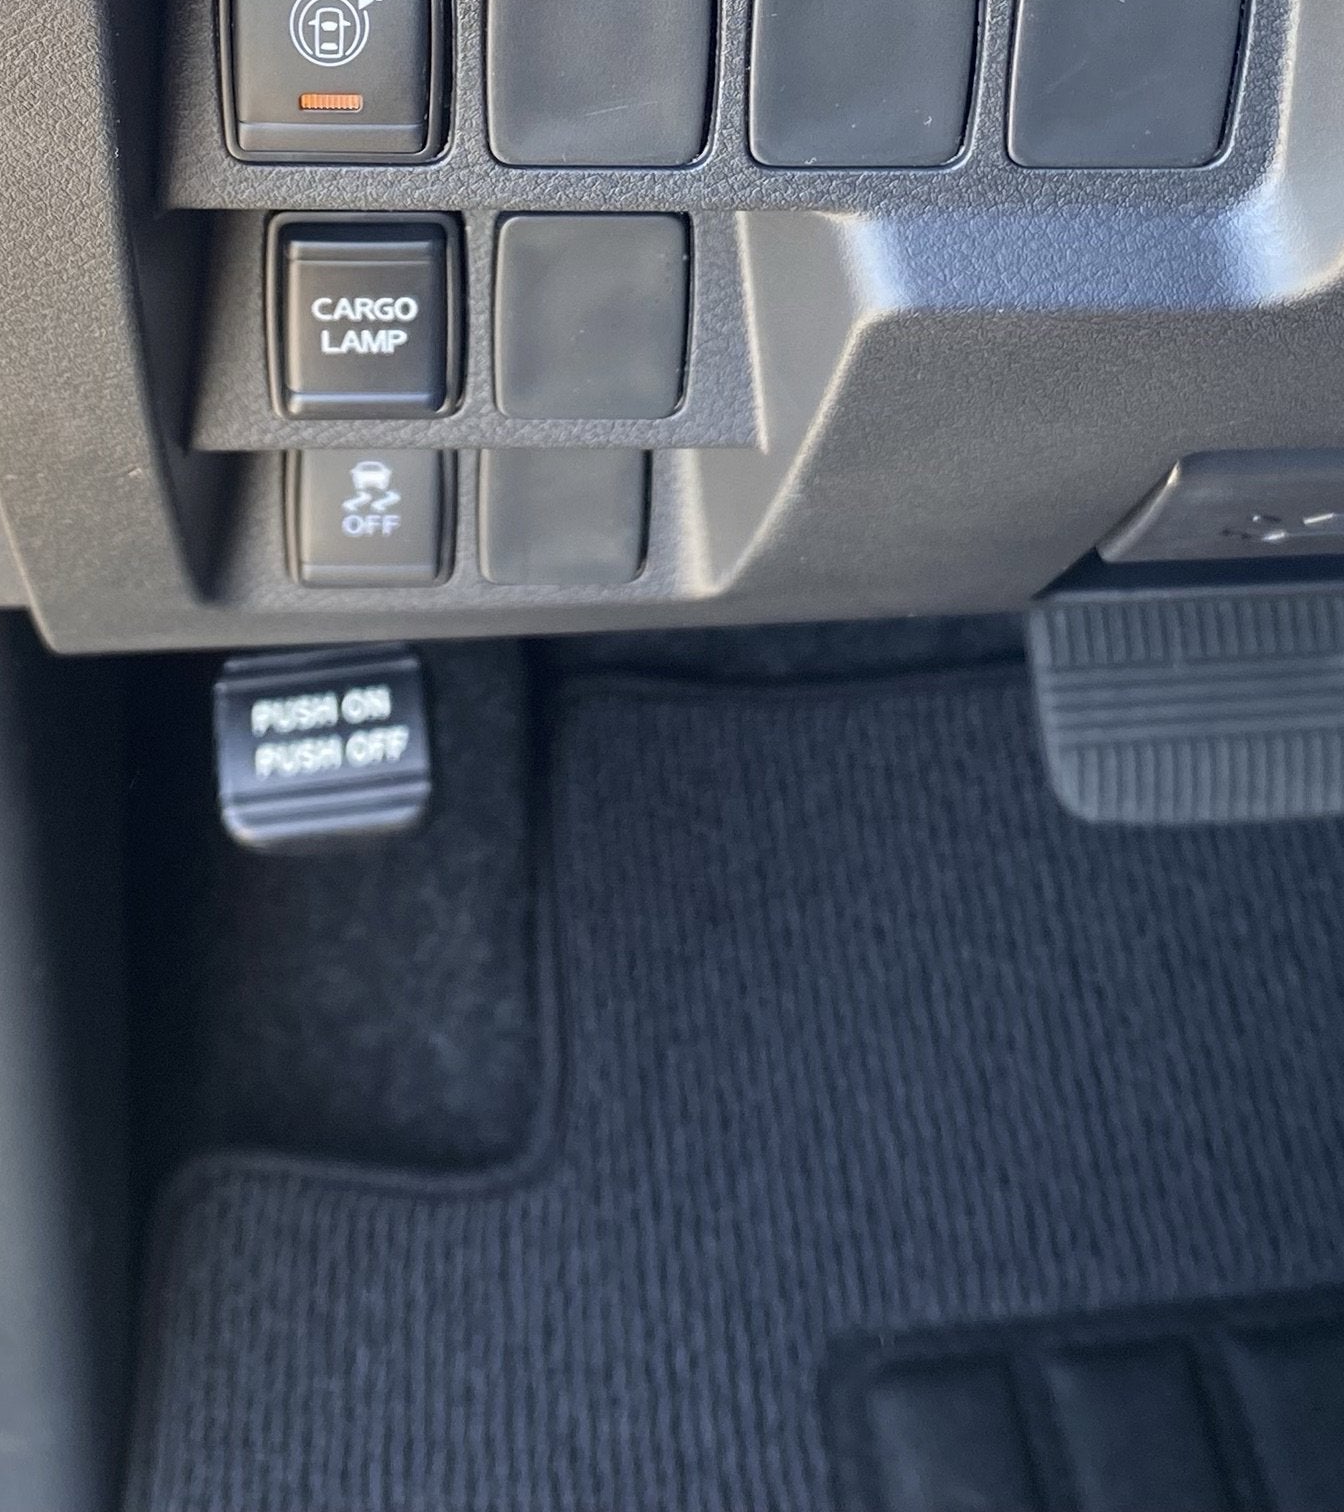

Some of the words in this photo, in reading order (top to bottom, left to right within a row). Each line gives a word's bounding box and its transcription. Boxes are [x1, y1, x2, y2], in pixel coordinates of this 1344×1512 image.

[311, 296, 419, 322] CARGO
[320, 329, 409, 355] LAMP
[341, 514, 402, 536] OFF
[251, 691, 339, 738] PUSH
[341, 683, 392, 725] ON
[254, 734, 343, 780] PUSH
[345, 724, 410, 768] OFF
